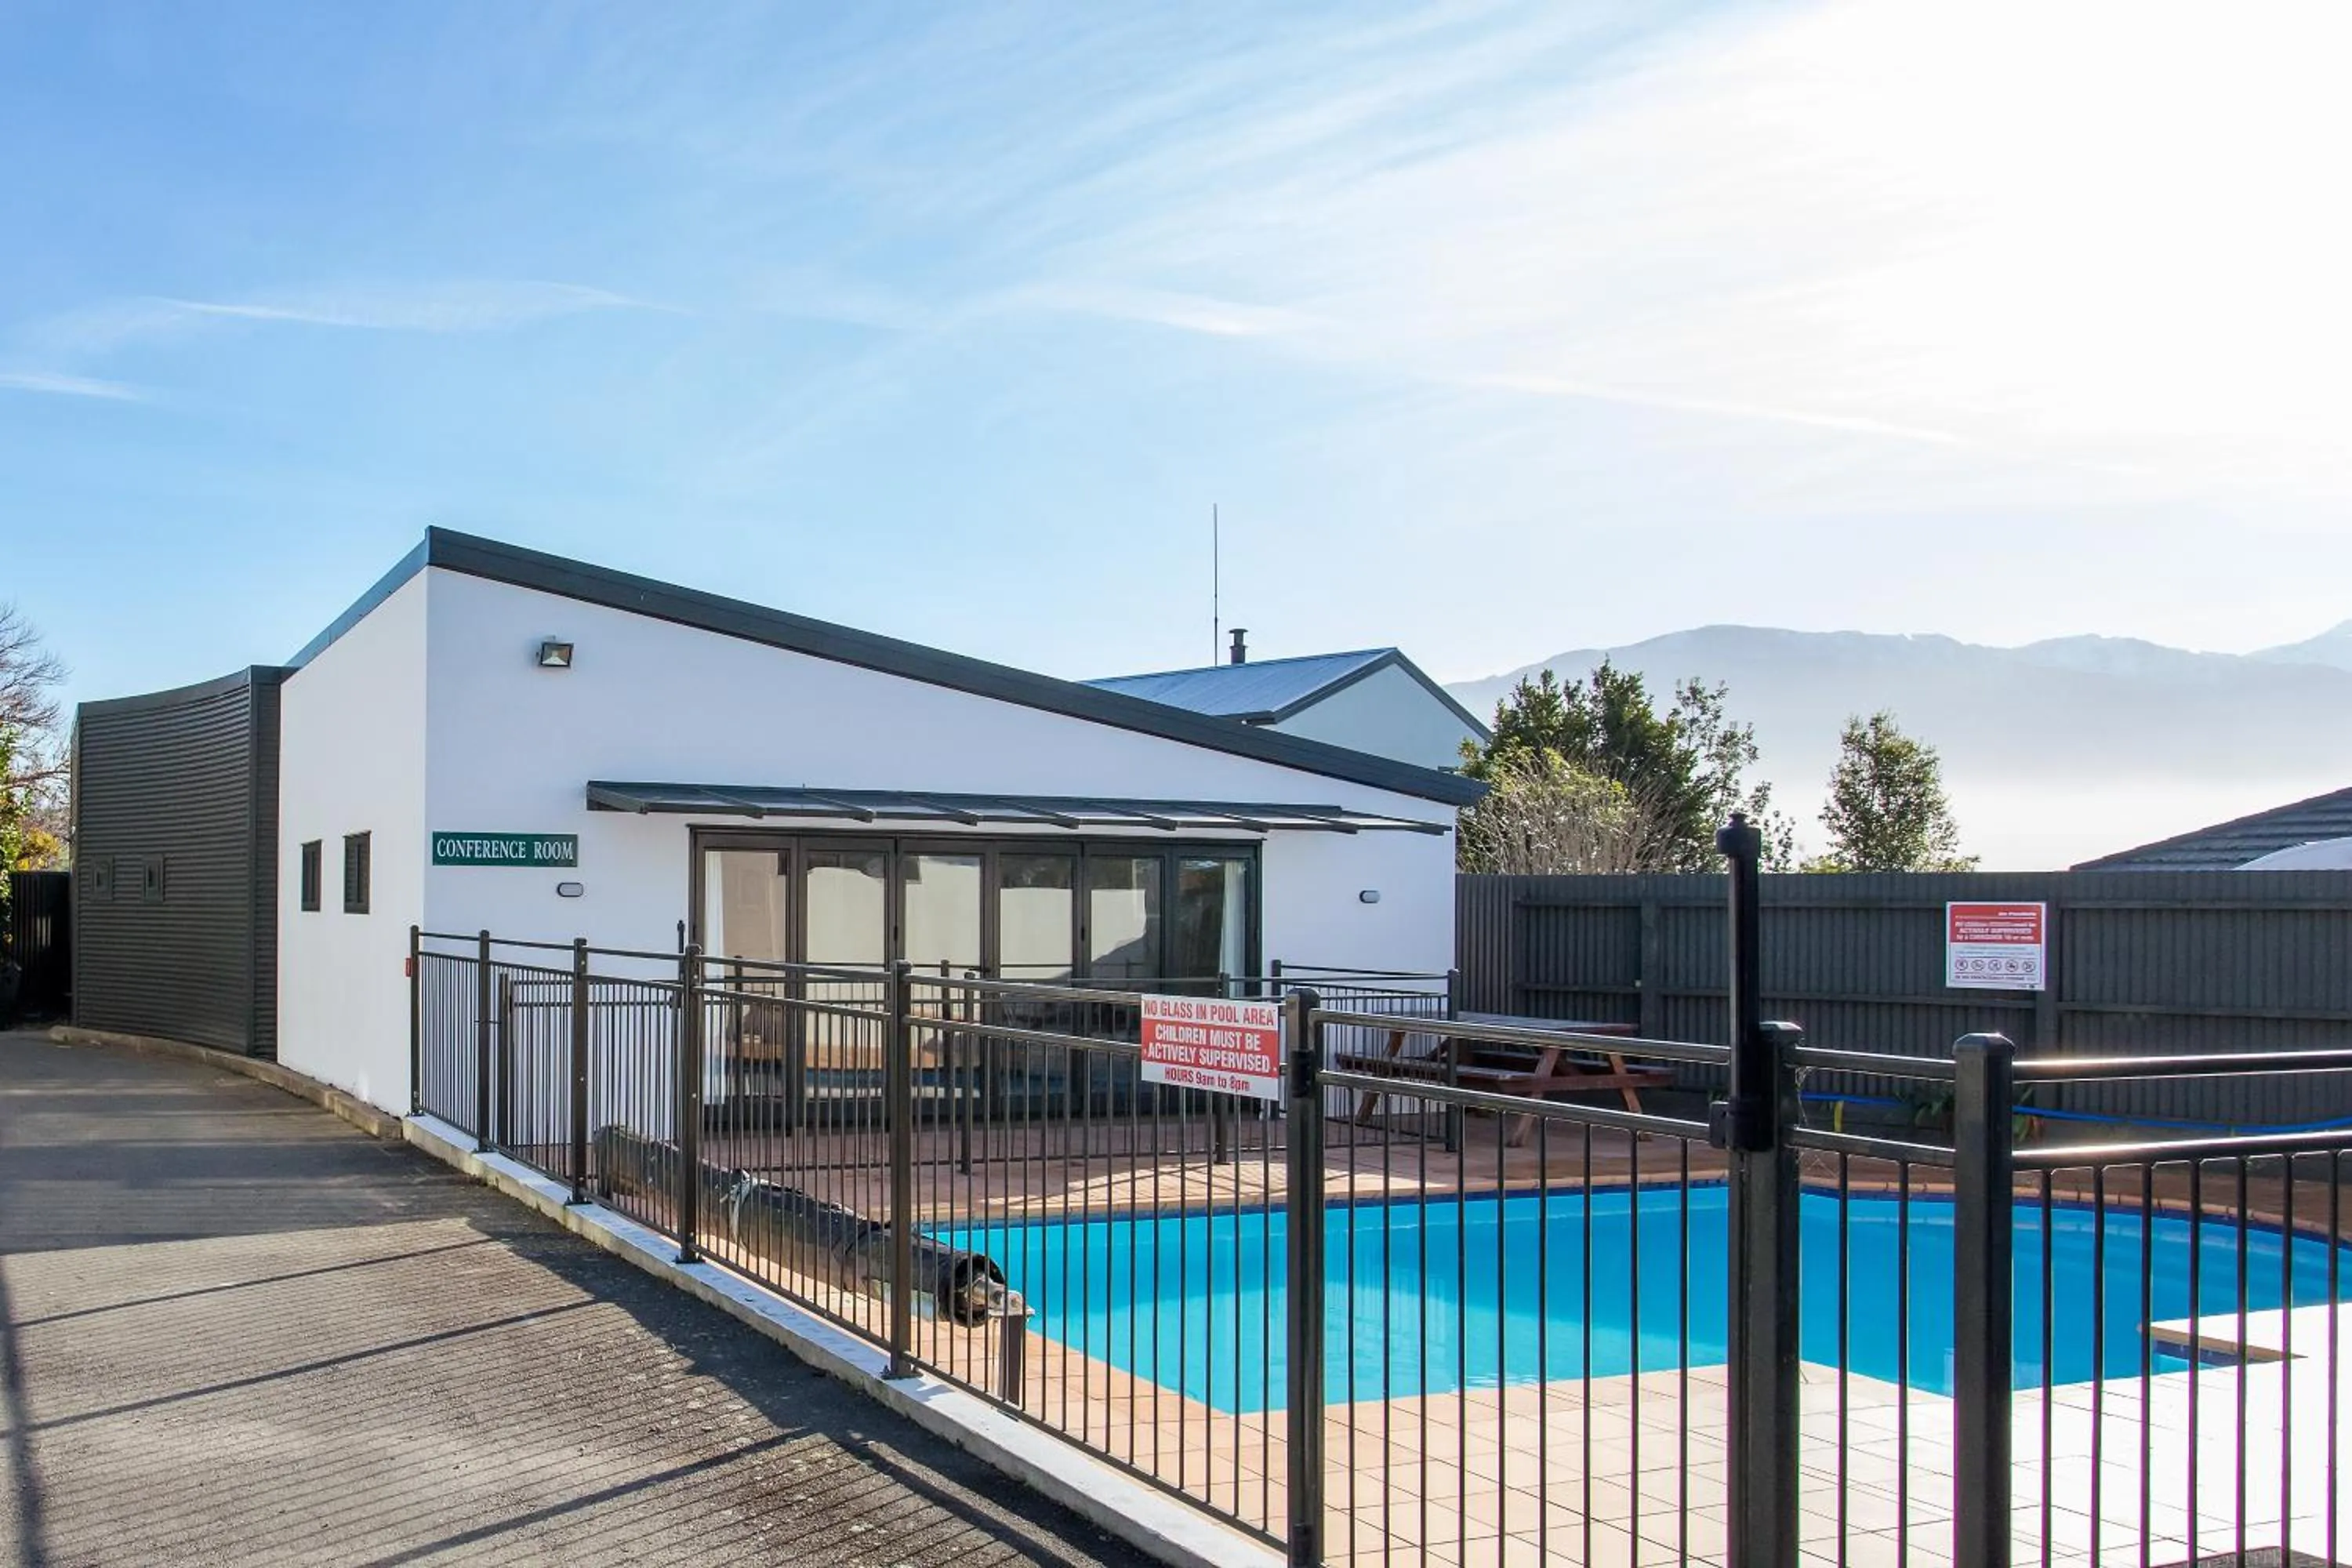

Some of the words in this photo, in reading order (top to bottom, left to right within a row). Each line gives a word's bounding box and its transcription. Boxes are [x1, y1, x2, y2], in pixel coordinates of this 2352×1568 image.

[437, 839, 526, 858] CONFERENCE
[534, 841, 573, 860] ROOM
[1144, 1000, 1158, 1015] NO
[1160, 1000, 1193, 1019] GLASS
[1196, 1003, 1207, 1019] IN
[1210, 1005, 1240, 1023] POOL
[1243, 1008, 1273, 1025] AREA
[1155, 1024, 1207, 1045] CHILDREN
[1210, 1030, 1243, 1049] MUST
[1245, 1033, 1261, 1051] BE
[1148, 1042, 1197, 1064] ACTIVELY
[1199, 1048, 1270, 1073] SUPERVISED
[1164, 1067, 1194, 1083] HOURS
[1196, 1072, 1214, 1085] 9am
[1218, 1076, 1227, 1089] to
